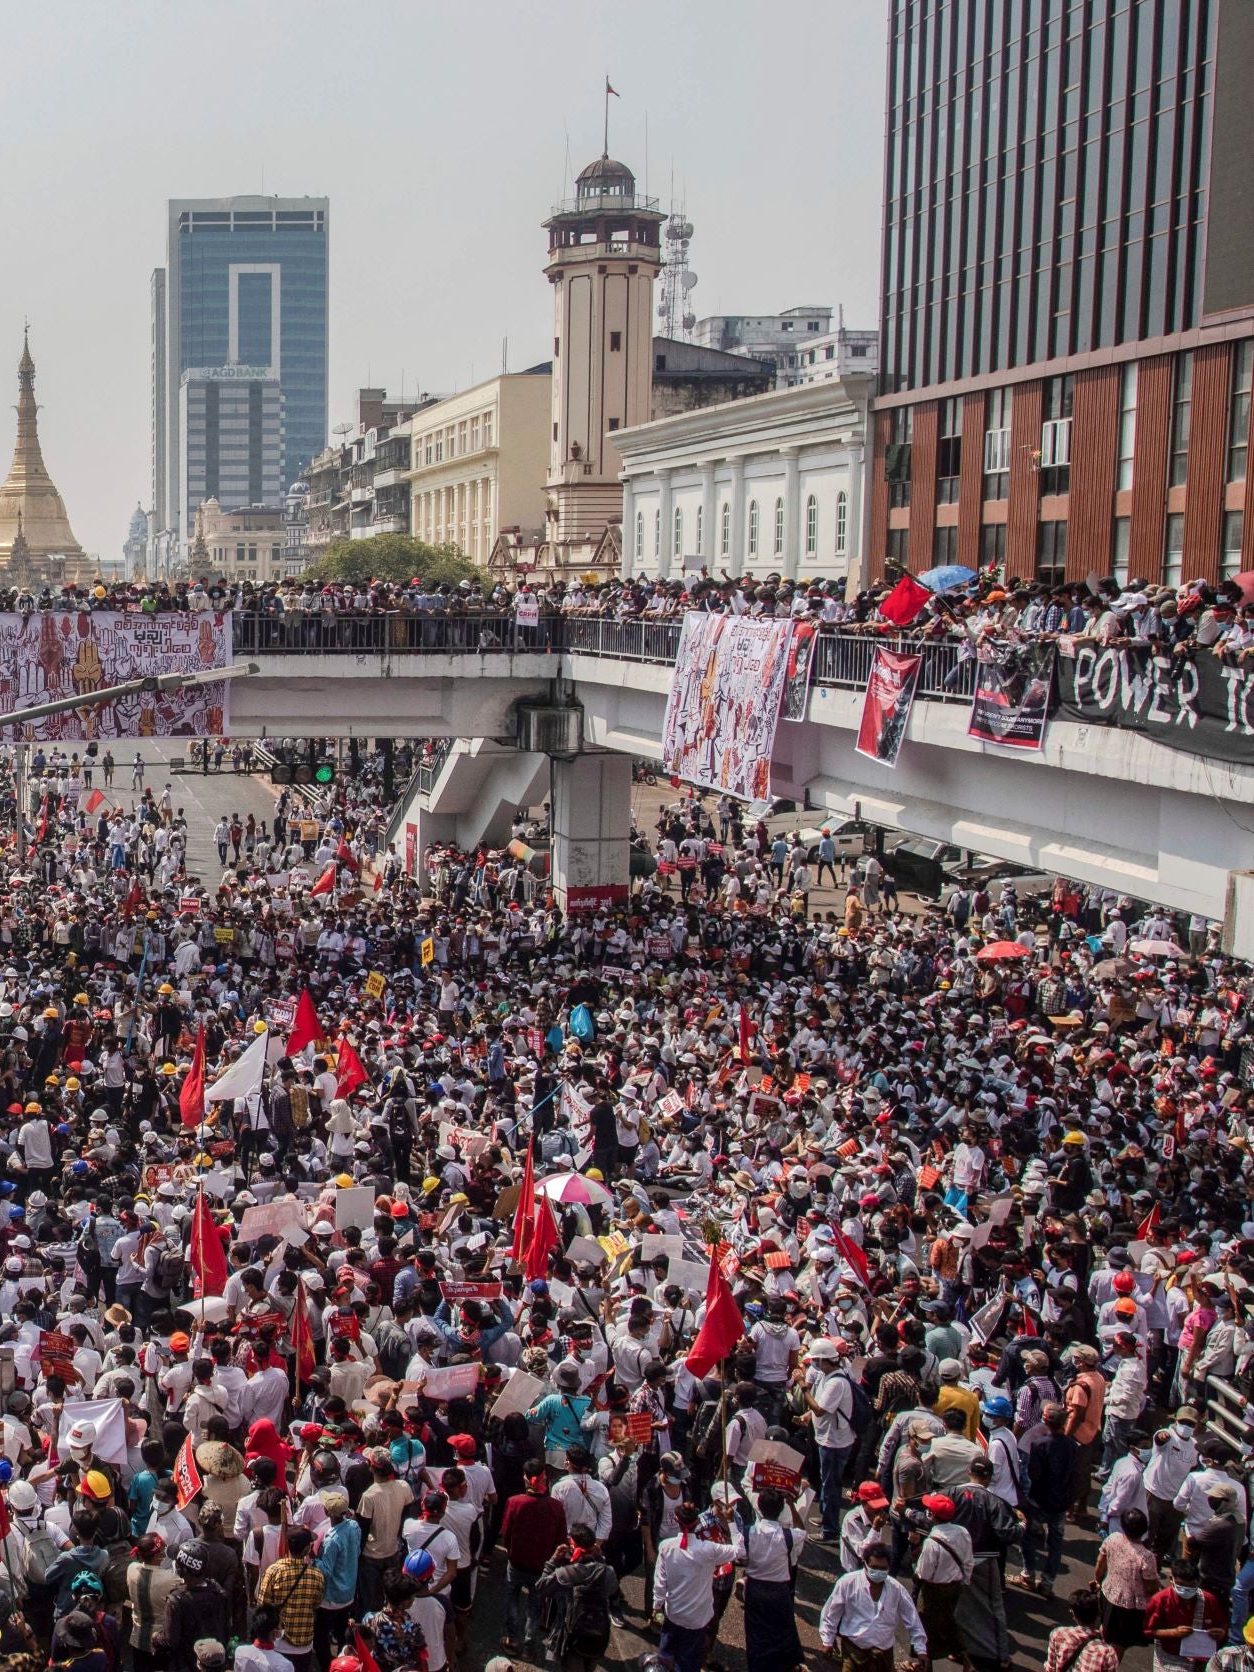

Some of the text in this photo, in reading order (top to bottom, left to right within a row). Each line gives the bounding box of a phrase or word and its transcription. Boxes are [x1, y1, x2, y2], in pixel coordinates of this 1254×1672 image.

[212, 368, 267, 377] AGD BANK
[1074, 648, 1199, 730] POWER
[177, 1549, 202, 1570] PRESS
